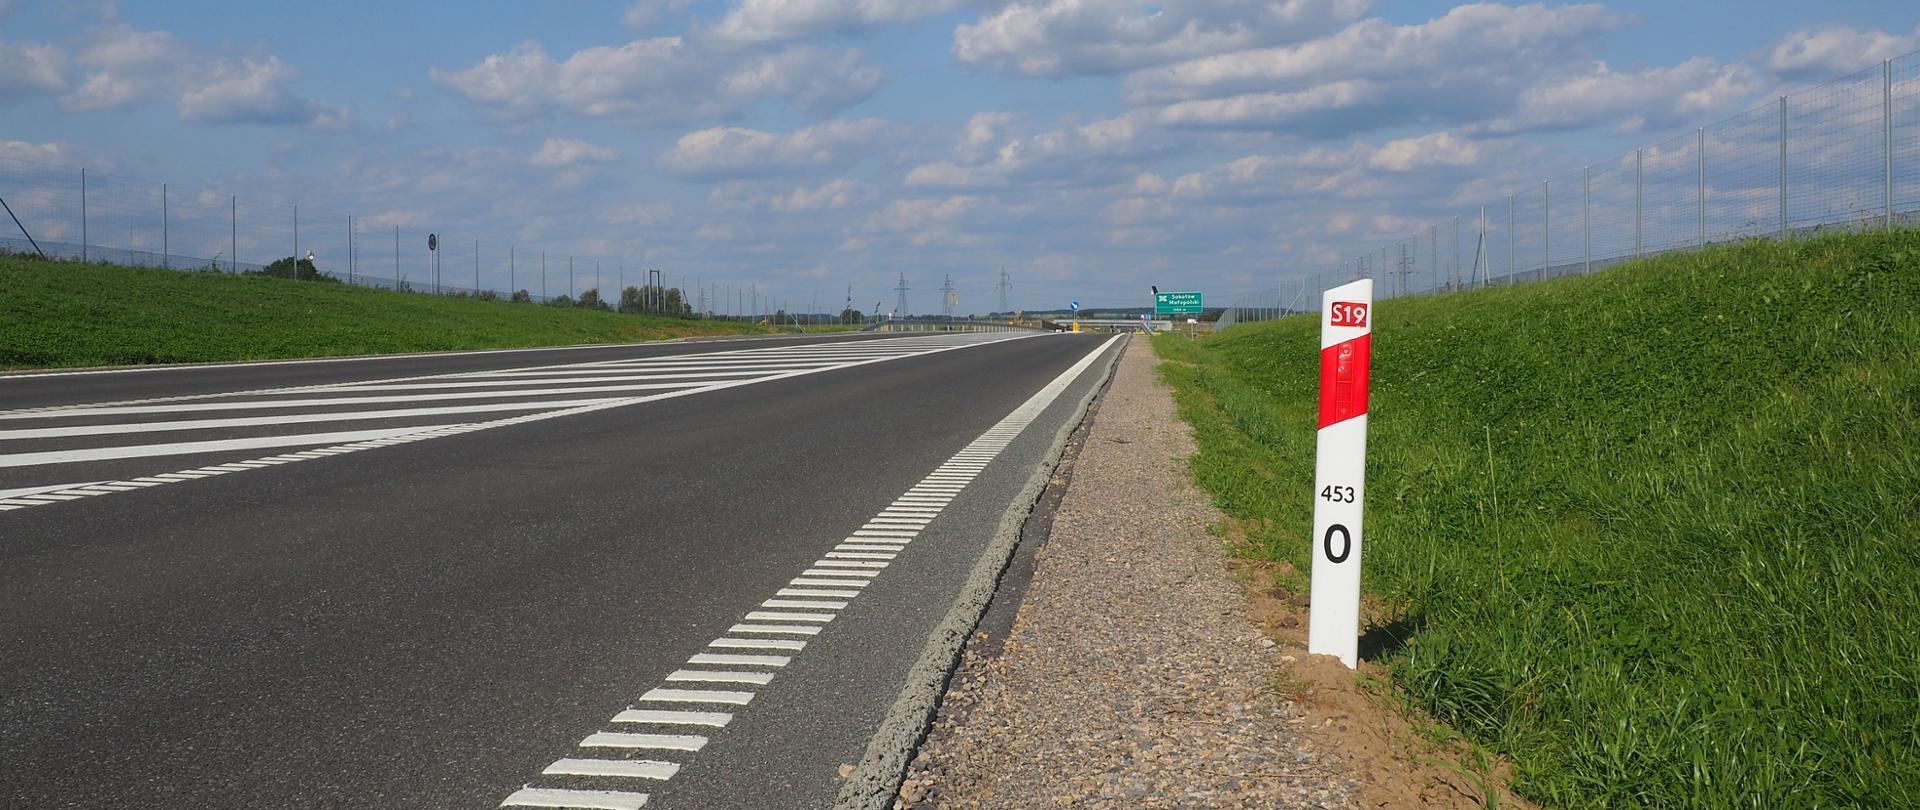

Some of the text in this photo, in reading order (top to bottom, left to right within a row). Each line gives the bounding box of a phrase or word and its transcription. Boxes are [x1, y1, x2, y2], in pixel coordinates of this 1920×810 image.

[1332, 304, 1366, 324] S19
[1320, 485, 1355, 504] 453
[1324, 524, 1351, 563] 0
